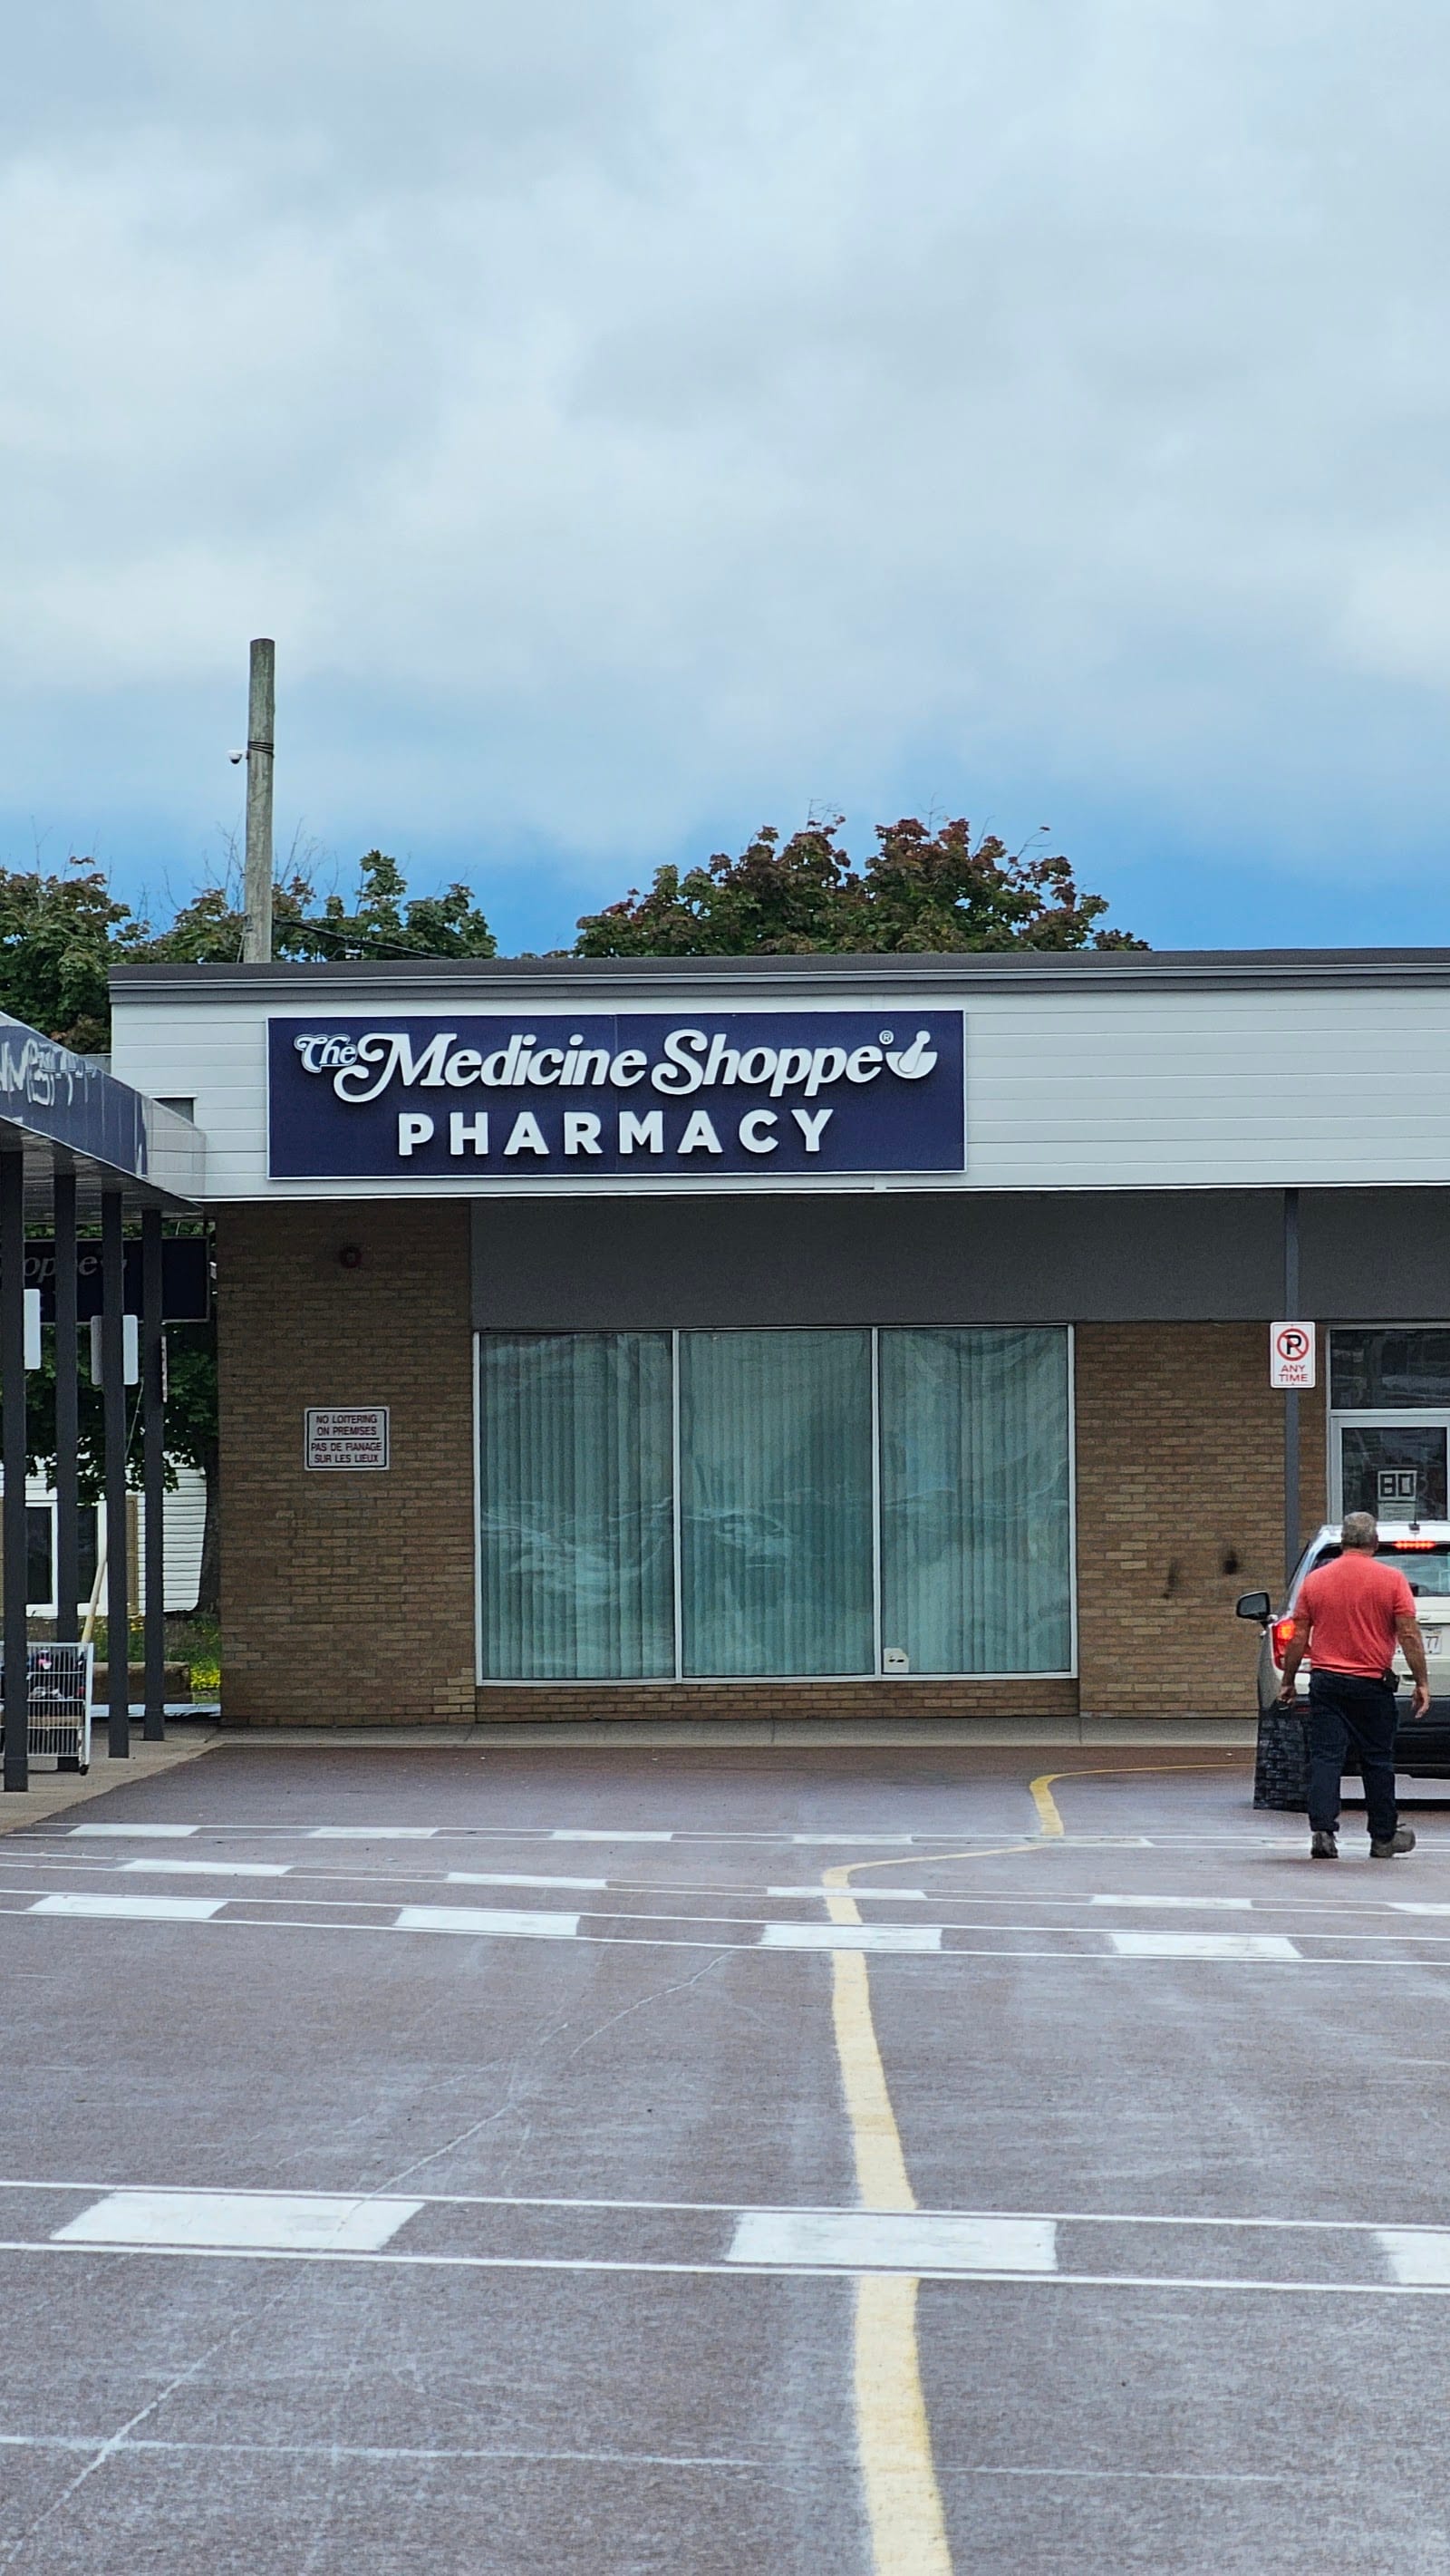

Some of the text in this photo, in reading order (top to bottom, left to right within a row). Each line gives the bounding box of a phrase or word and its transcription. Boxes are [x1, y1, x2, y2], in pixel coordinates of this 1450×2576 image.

[295, 1035, 356, 1072] The
[334, 1033, 647, 1103] Medicine
[652, 1030, 883, 1097] Shoppe
[398, 1109, 834, 1156] PHARMACY
[1281, 1364, 1305, 1372] ANY
[1279, 1373, 1309, 1382] TIME
[316, 1414, 378, 1424] NO LOITERING
[317, 1426, 377, 1436] ON PREMISES
[311, 1442, 327, 1451] PAS
[330, 1442, 343, 1451] DE
[314, 1453, 379, 1463] SUR LES LIEUX
